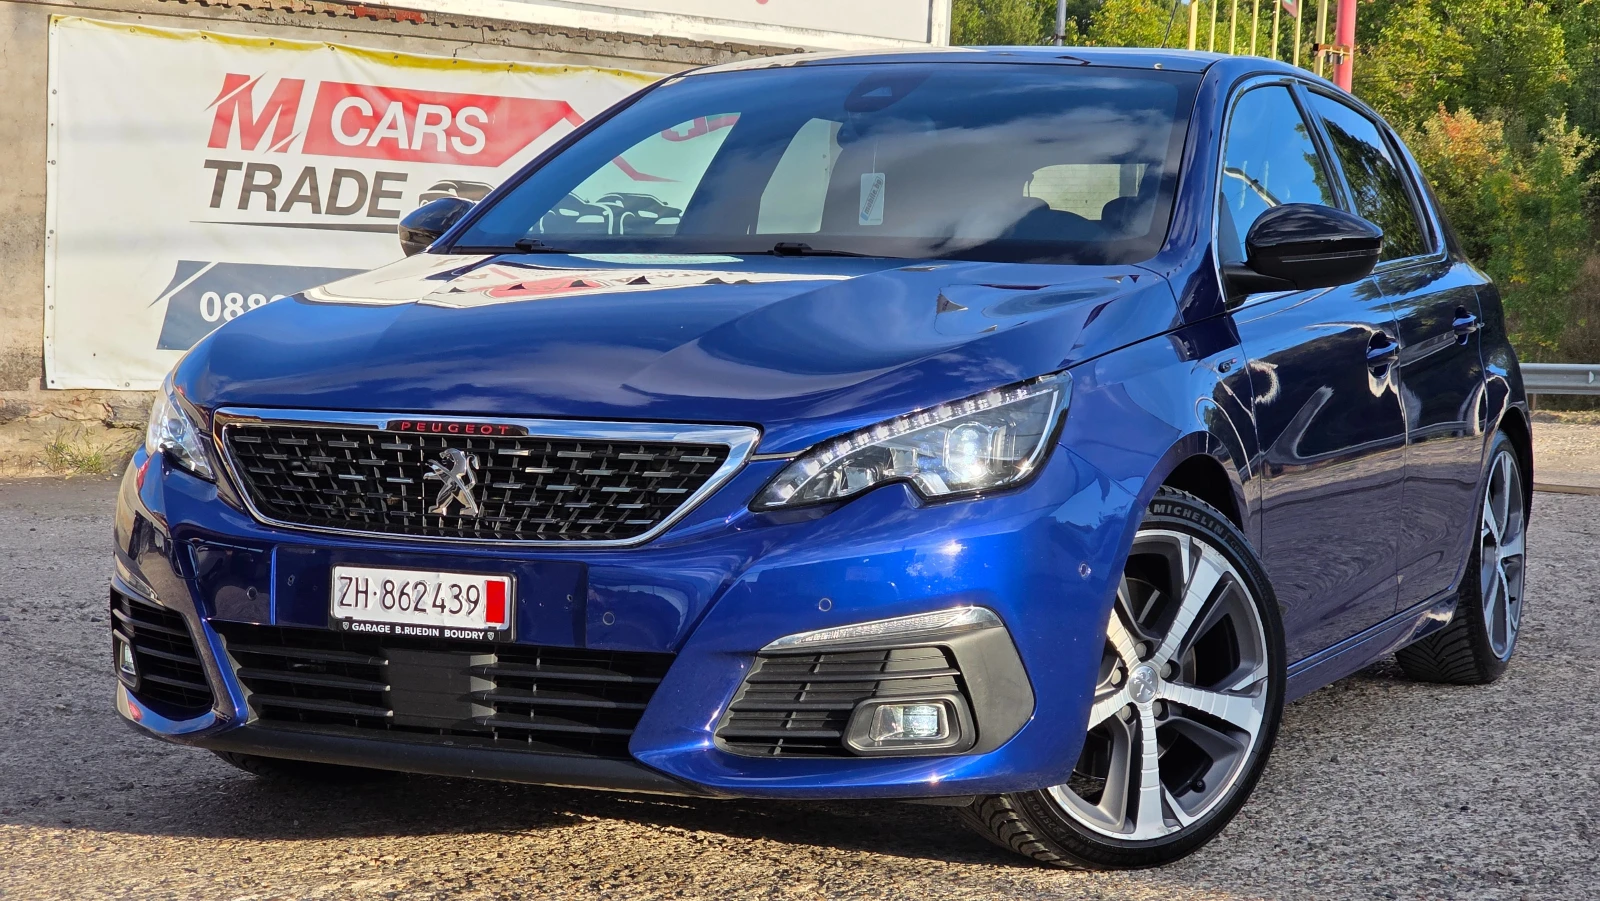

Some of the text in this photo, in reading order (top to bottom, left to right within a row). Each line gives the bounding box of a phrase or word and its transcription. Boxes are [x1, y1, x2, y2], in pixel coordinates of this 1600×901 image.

[203, 71, 489, 155] M CARS
[203, 159, 408, 219] TRADE
[200, 291, 286, 323] 088
[401, 421, 510, 435] PEUGEOT
[1153, 503, 1225, 537] MICHELIN
[352, 622, 484, 640] GARAGE B.RUEDIN BOUDRY
